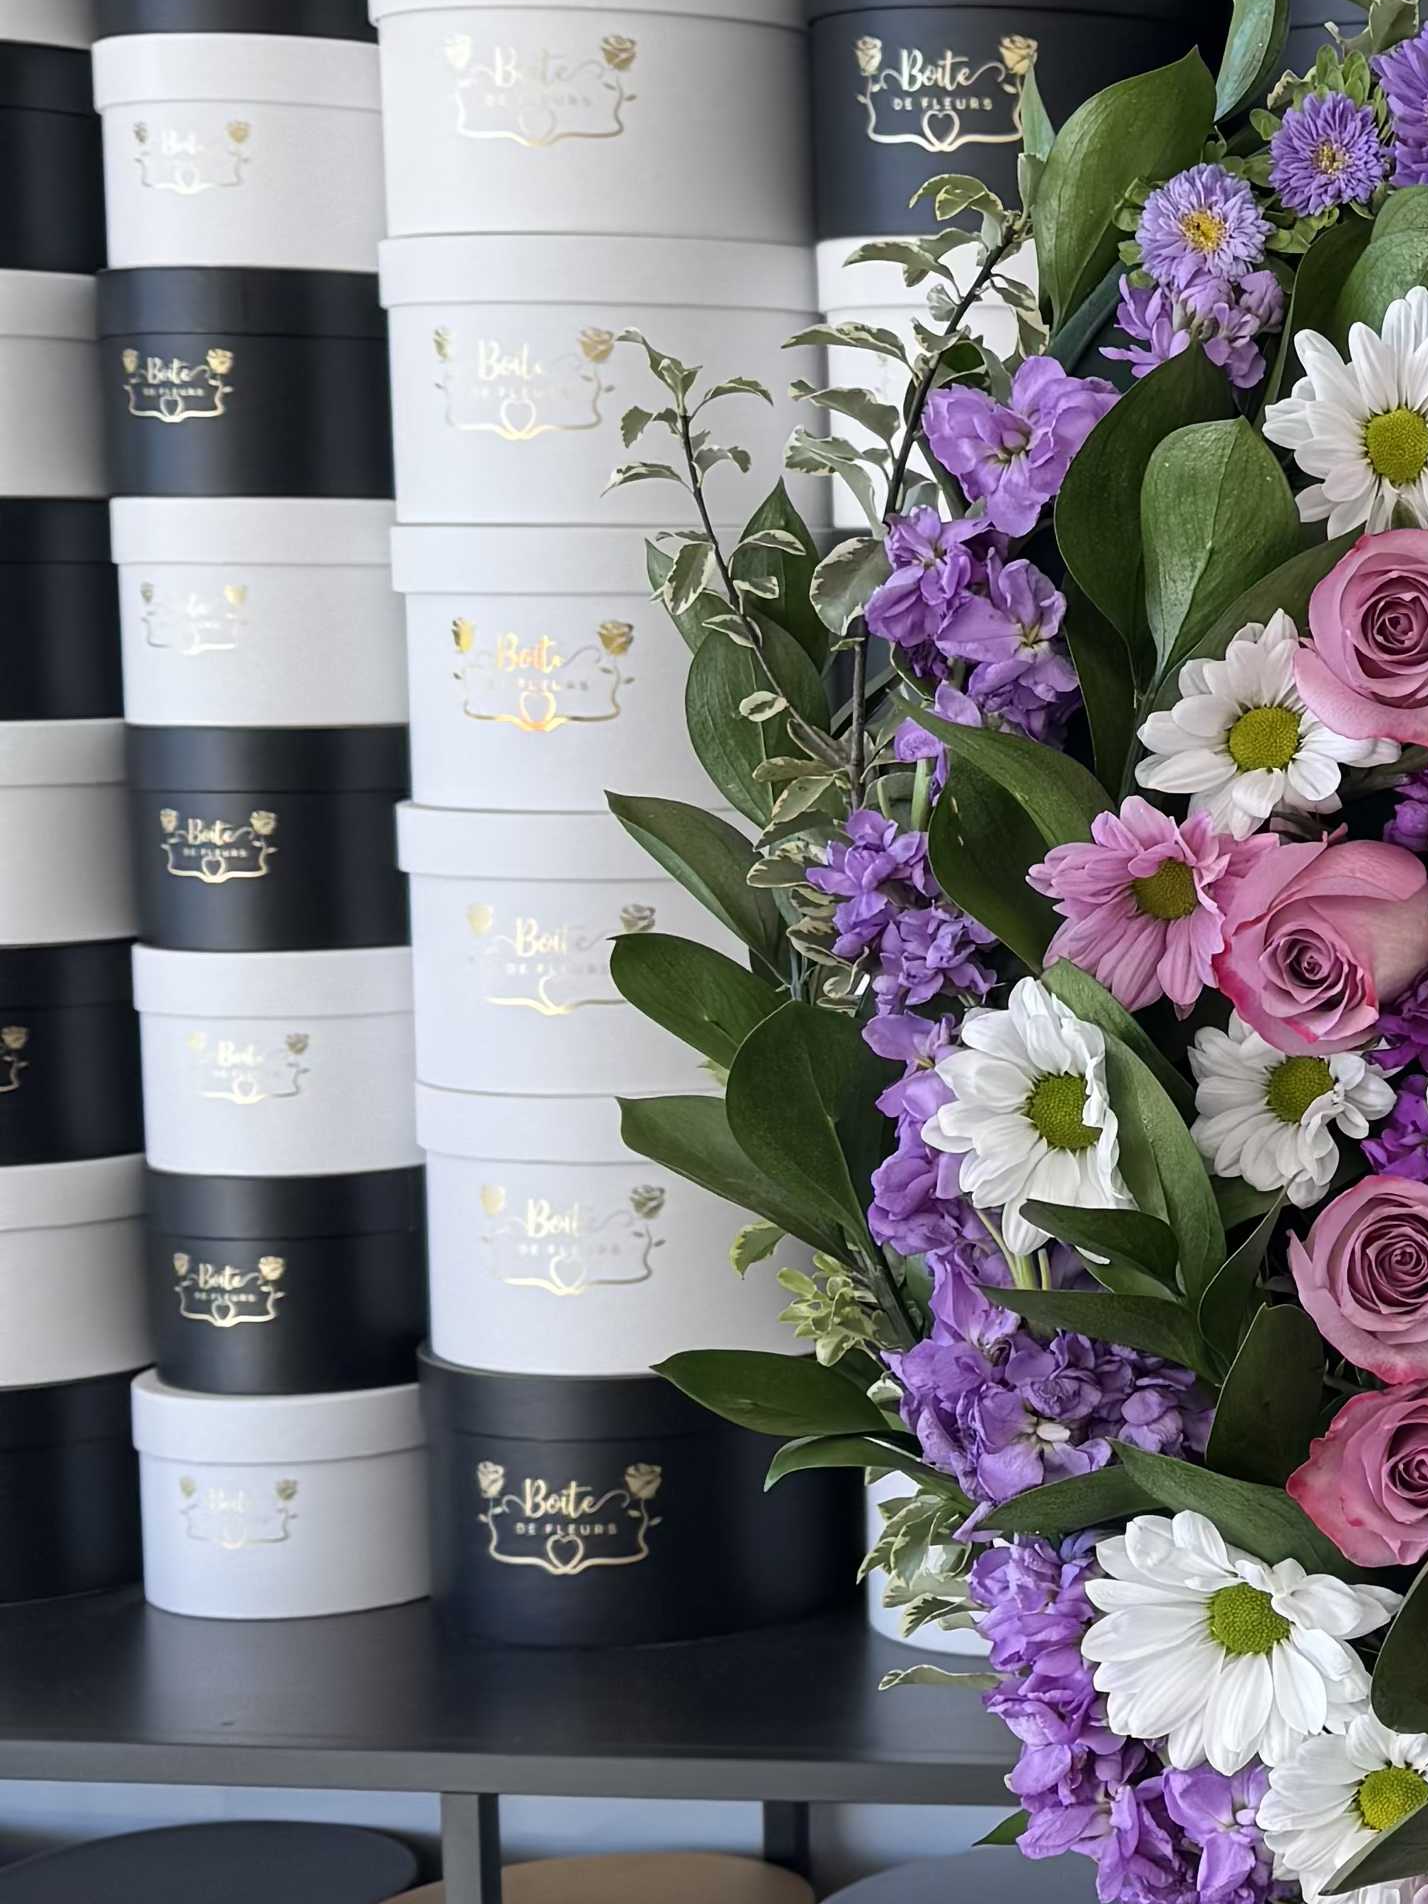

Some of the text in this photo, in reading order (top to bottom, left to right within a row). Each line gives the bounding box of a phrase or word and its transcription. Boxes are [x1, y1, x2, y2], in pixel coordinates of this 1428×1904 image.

[893, 96, 993, 111] DE FLEURS
[514, 1522, 616, 1536] DE FLEURS
